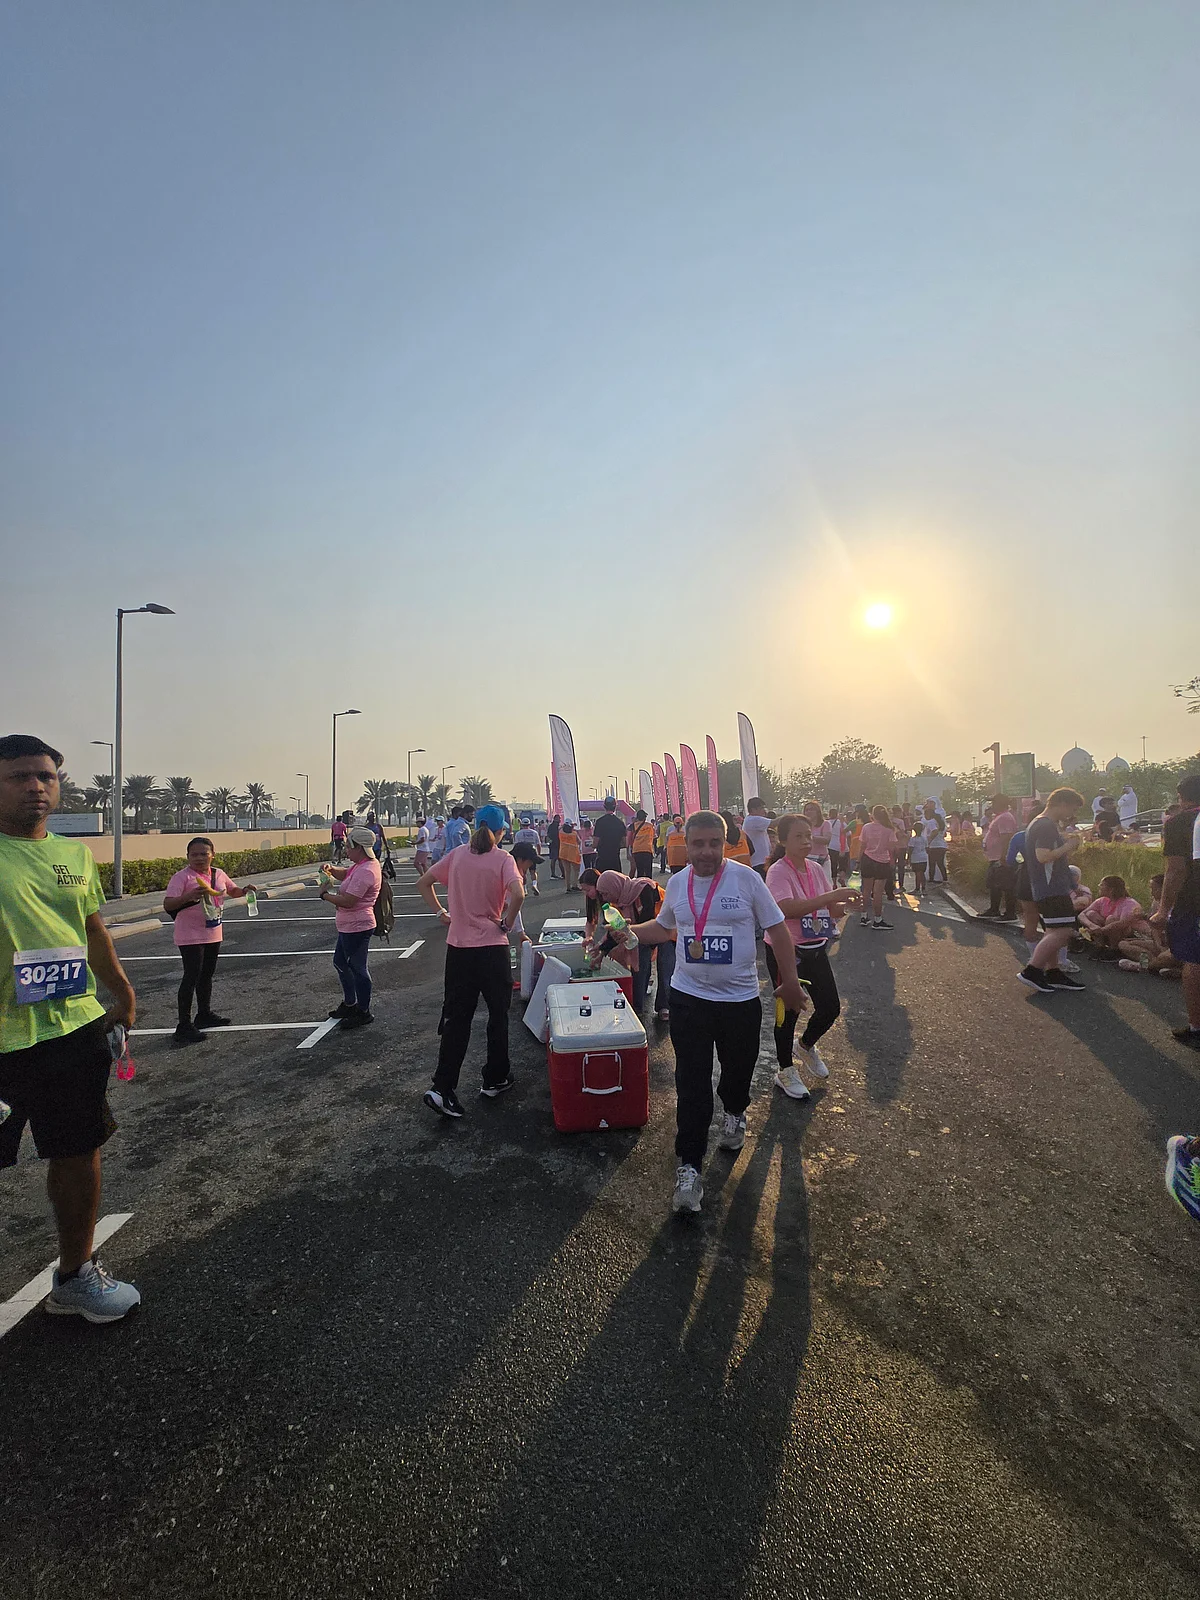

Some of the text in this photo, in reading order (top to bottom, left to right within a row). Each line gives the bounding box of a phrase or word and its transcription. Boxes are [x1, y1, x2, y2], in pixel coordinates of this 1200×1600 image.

[52, 864, 70, 874] GET
[57, 875, 87, 885] ACTIVE!
[801, 917, 829, 929] 3096
[687, 938, 729, 951] 146
[20, 961, 82, 985] 30217
